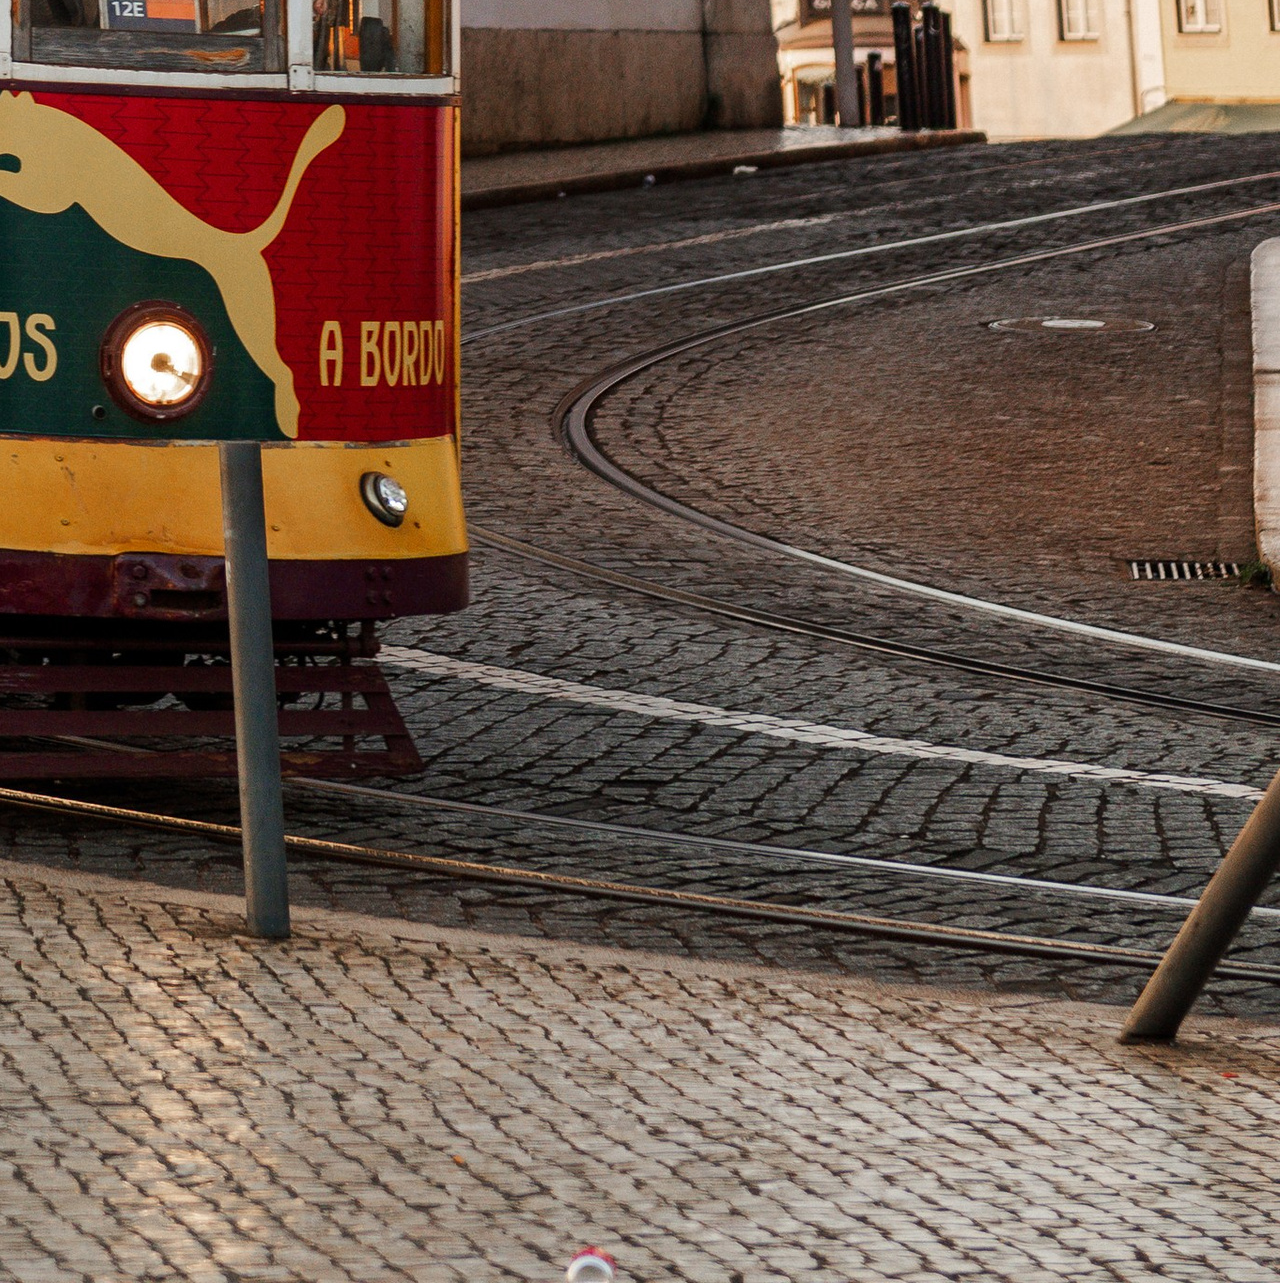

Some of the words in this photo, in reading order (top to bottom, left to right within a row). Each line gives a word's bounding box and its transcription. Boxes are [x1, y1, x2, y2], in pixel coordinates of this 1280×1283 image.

[111, 1, 145, 17] 12E
[319, 320, 344, 386] A
[360, 320, 445, 387] BORDO
